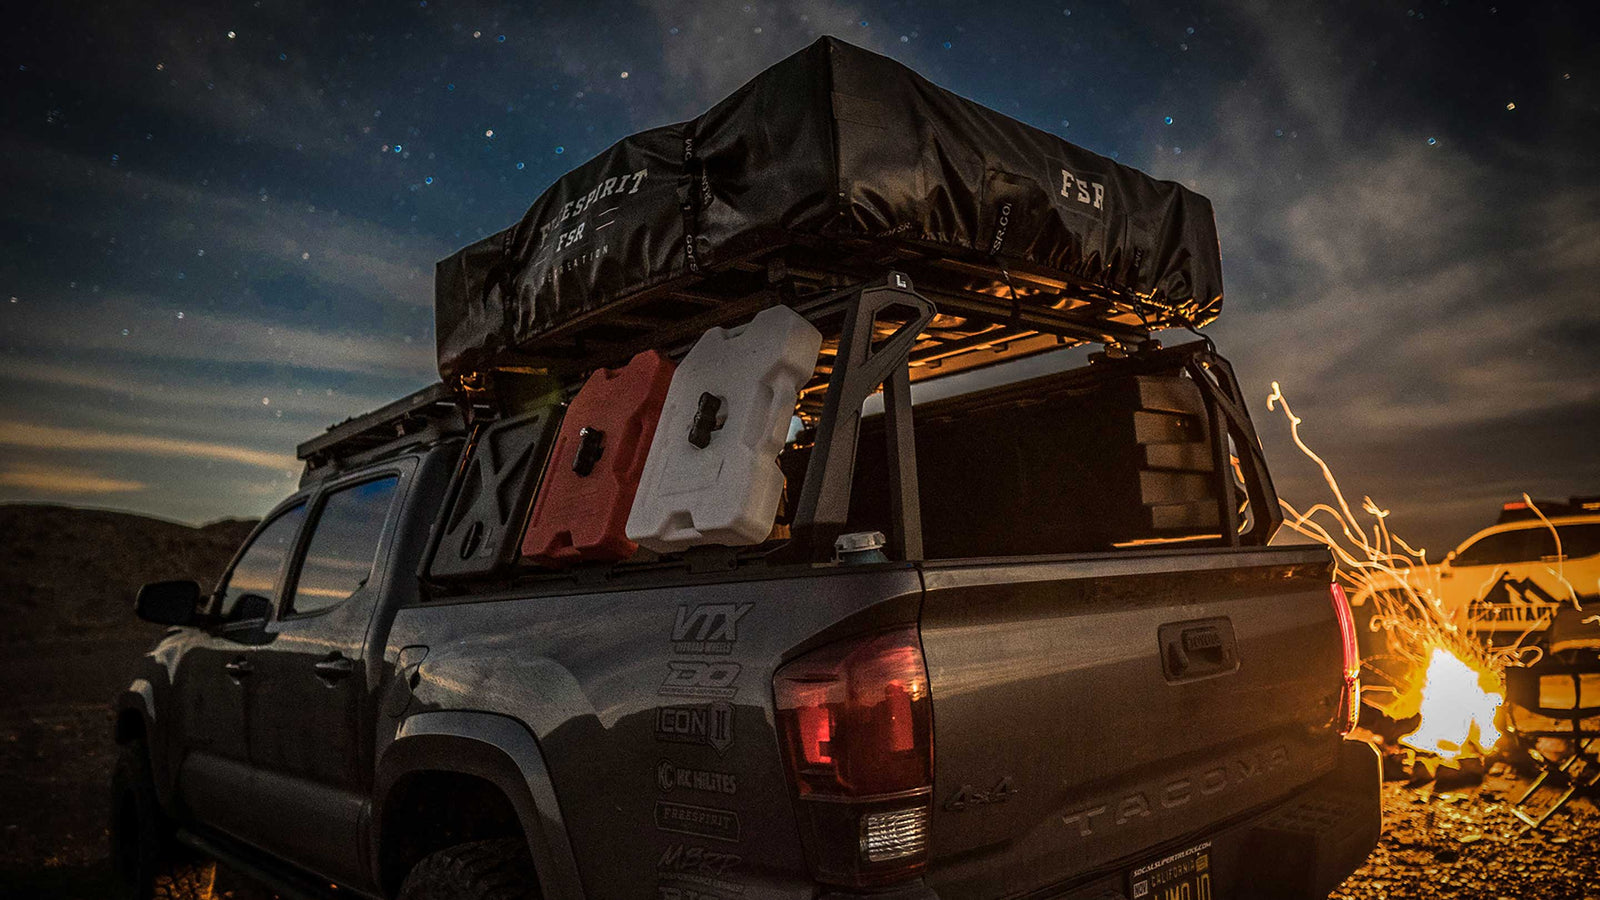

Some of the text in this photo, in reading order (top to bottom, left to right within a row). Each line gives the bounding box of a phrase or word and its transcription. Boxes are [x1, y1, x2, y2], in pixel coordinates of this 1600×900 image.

[1061, 169, 1105, 211] FSR
[556, 222, 586, 252] FSR
[990, 202, 1013, 256] SR.CO
[670, 602, 756, 642] VTX
[655, 706, 707, 737] ICON
[1062, 744, 1290, 837] TACOMA
[664, 807, 731, 829] FREESPIRIT
[1151, 860, 1194, 888] CALIFORNIA
